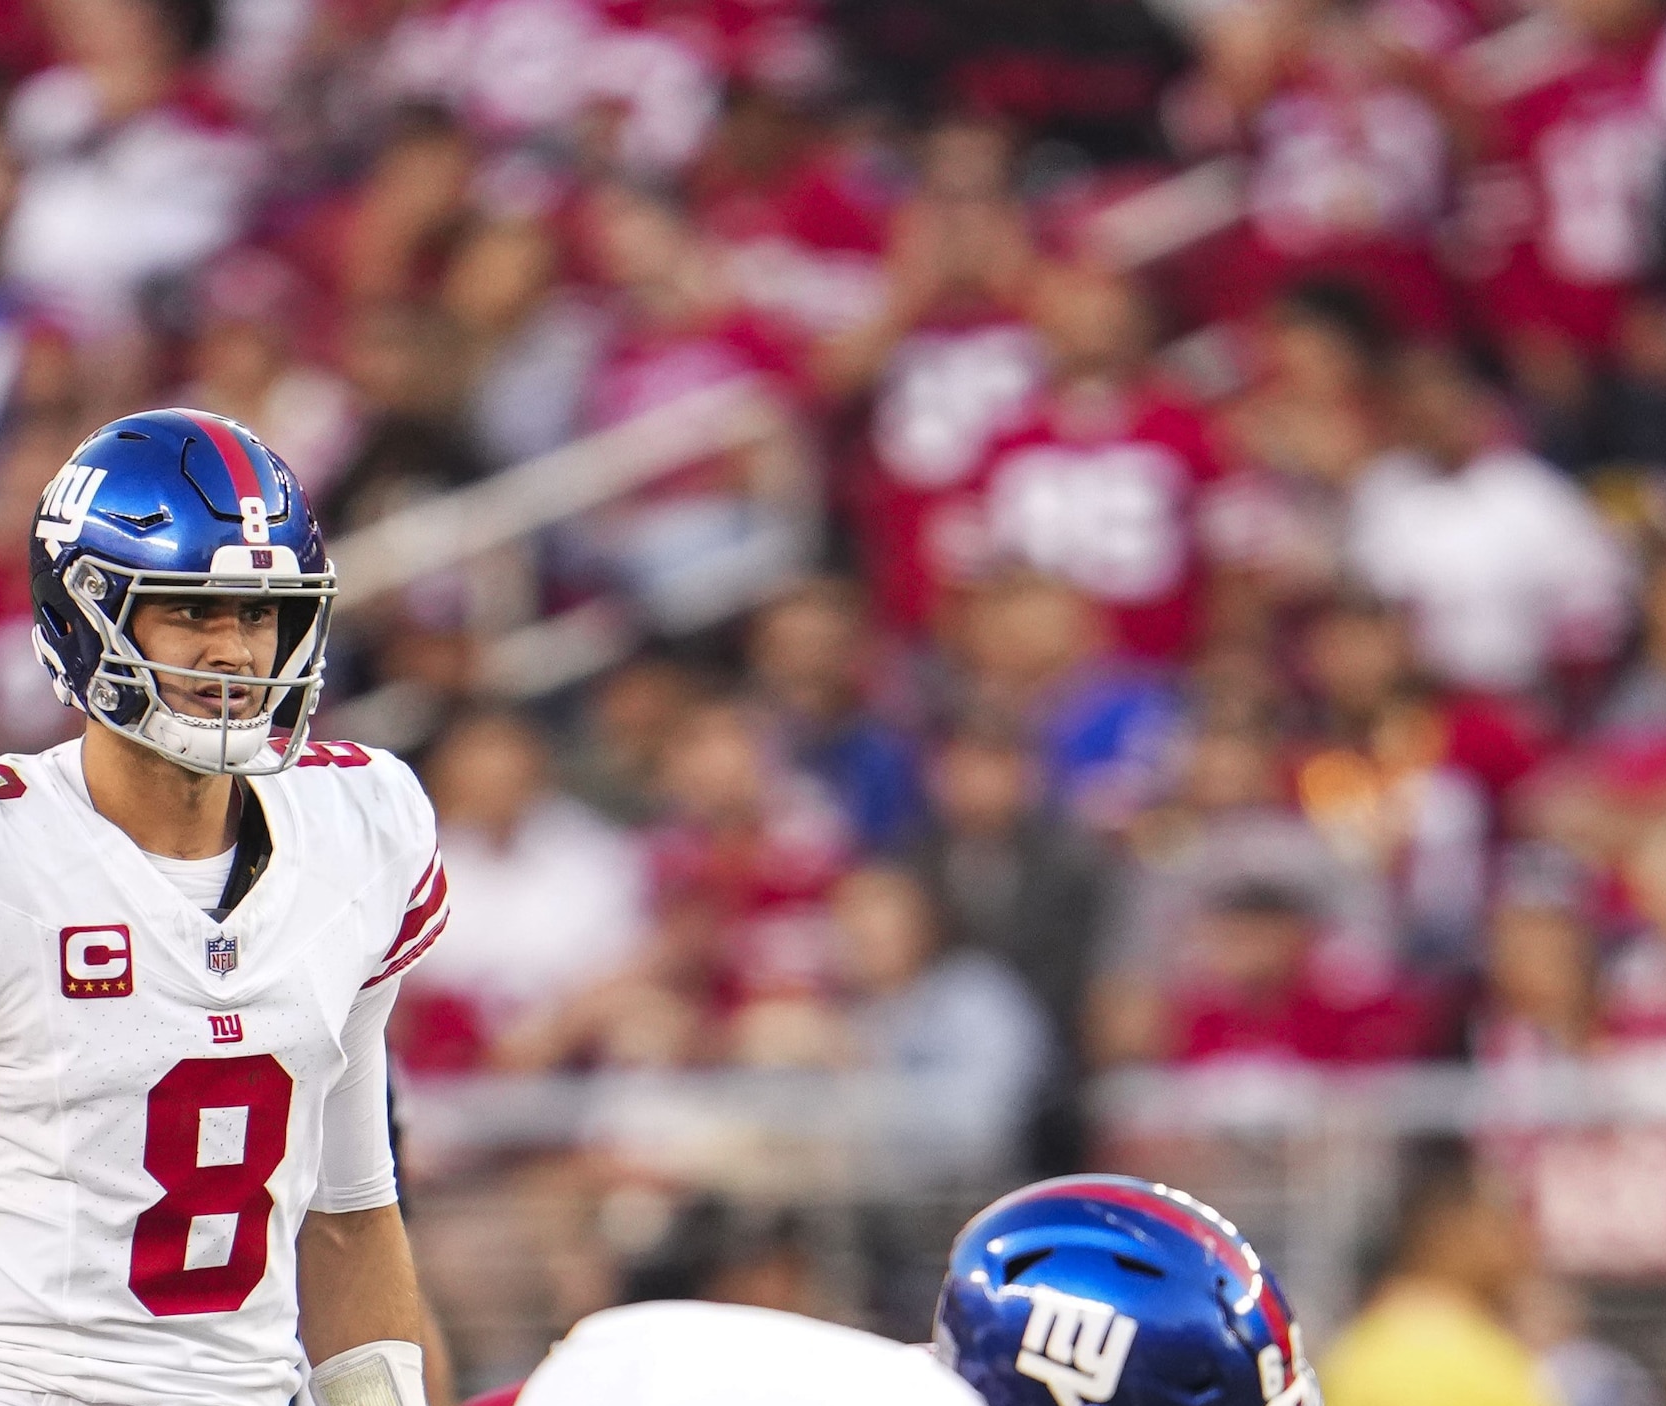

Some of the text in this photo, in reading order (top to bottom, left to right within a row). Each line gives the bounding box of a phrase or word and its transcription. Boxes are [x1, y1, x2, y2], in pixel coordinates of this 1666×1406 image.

[239, 496, 270, 543] 8
[65, 930, 127, 980] C
[212, 953, 234, 970] NFL
[128, 1053, 293, 1317] 8
